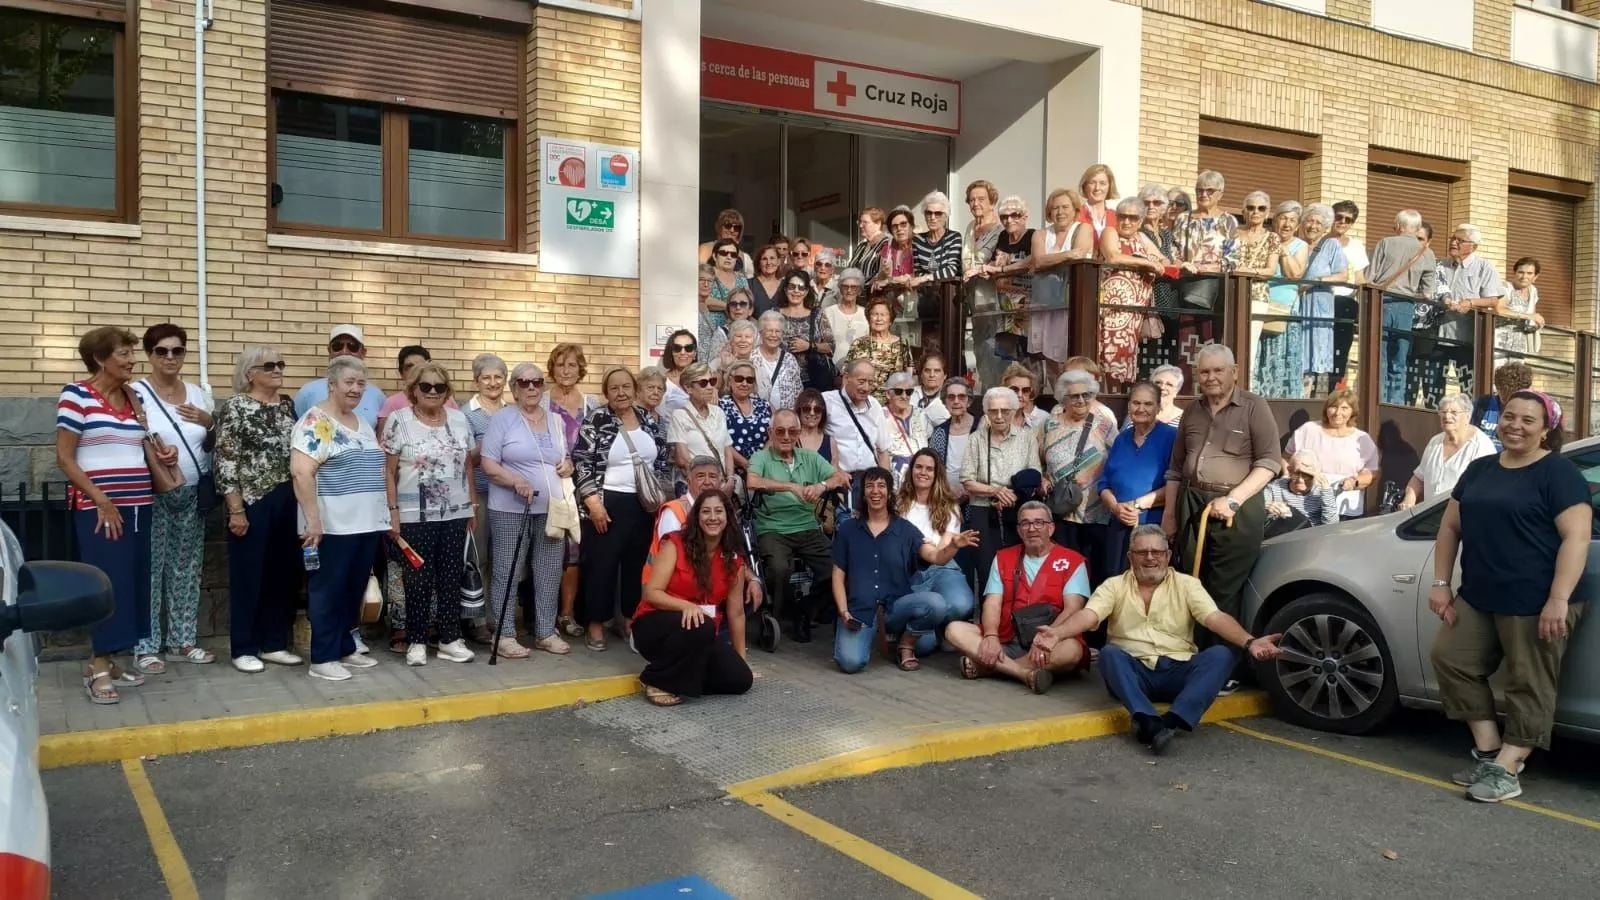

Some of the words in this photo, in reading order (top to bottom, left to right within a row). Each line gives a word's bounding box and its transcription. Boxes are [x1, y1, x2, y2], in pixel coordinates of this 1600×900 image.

[708, 62, 736, 76] cerca
[738, 64, 750, 78] de
[752, 66, 767, 81] las
[768, 71, 810, 88] personas
[865, 84, 906, 105] Cruz
[911, 91, 948, 114] Roja
[590, 217, 607, 225] DESA
